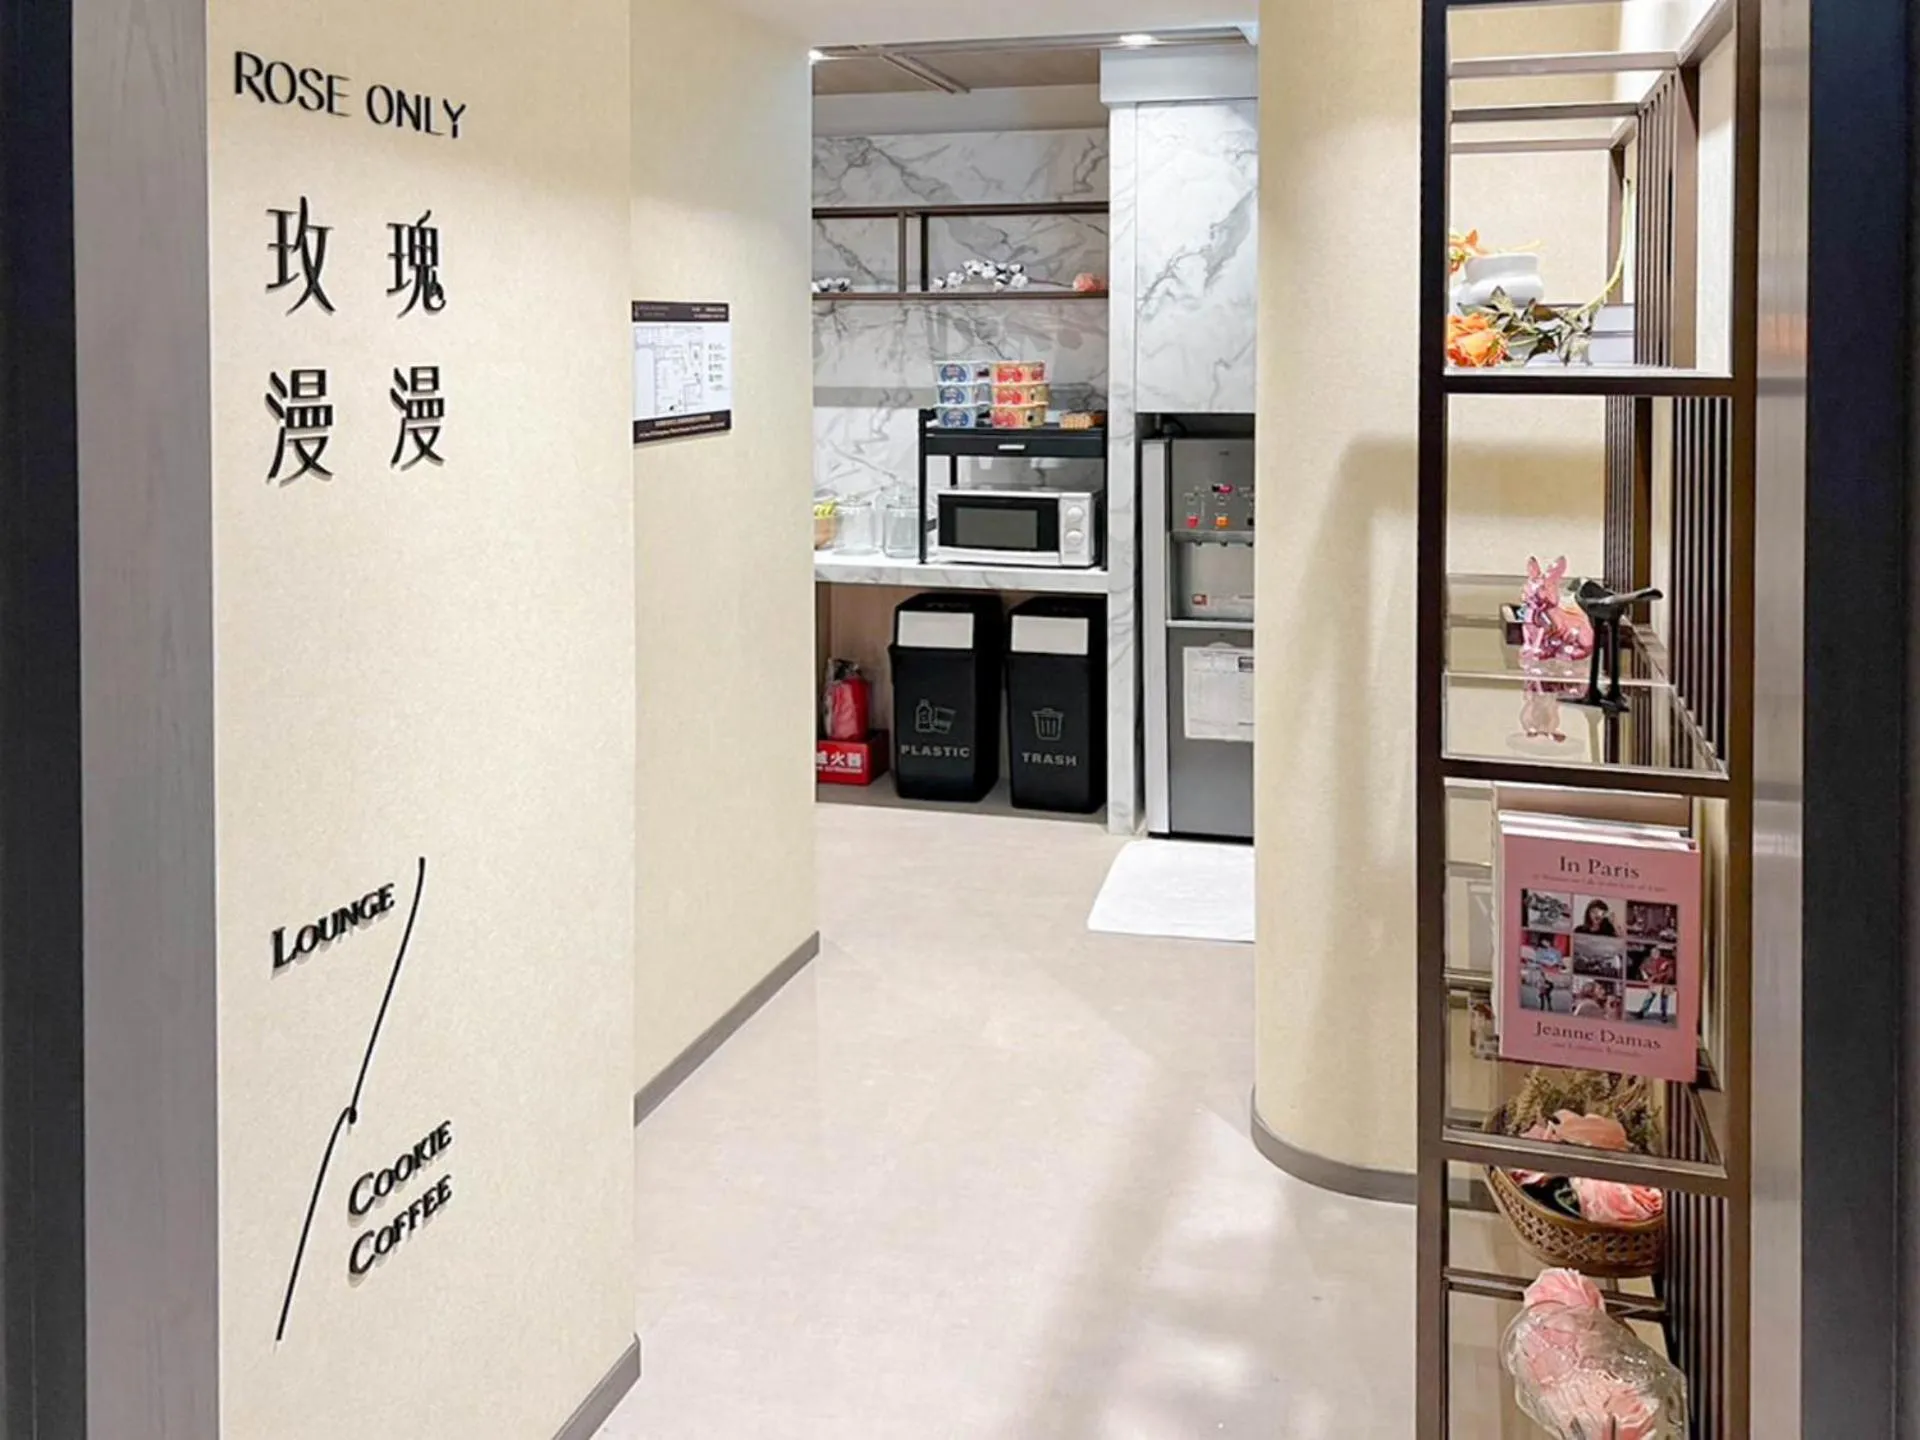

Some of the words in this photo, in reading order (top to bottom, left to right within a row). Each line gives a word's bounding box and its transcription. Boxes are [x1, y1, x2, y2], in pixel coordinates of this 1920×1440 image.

[233, 51, 352, 117] ROSE
[366, 84, 466, 138] ONLY
[265, 196, 447, 318] 玫瑰
[264, 366, 447, 485] 漫漫
[900, 743, 971, 758] PLASTIC
[1021, 751, 1078, 767] TRASH
[1559, 855, 1580, 873] In
[1588, 858, 1640, 879] Paris
[271, 882, 395, 970] LOUNGE
[1535, 1020, 1595, 1042] Jeanne
[1600, 1028, 1662, 1050] Damas
[348, 1120, 451, 1217] COOKIE
[348, 1174, 451, 1275] COFFEE
